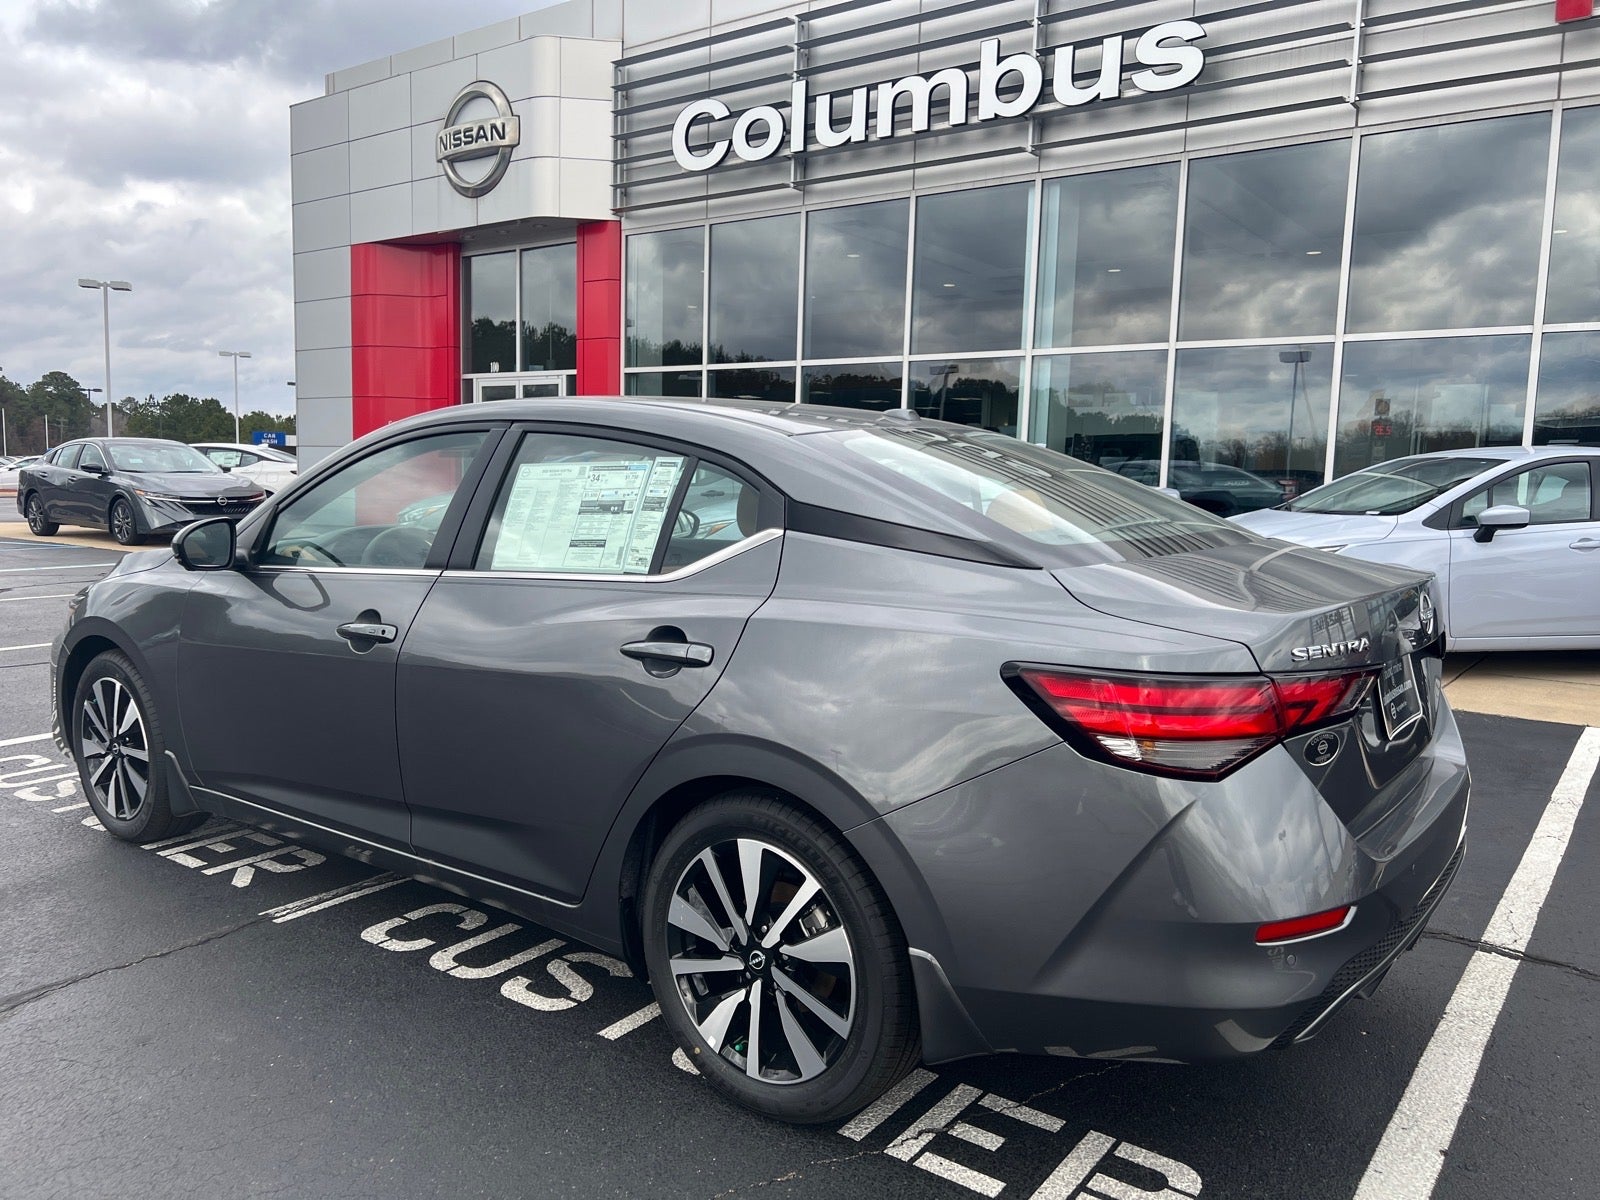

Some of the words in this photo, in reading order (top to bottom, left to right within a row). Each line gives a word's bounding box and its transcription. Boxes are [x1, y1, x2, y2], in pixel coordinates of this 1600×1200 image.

[671, 20, 1206, 171] Columbus
[438, 121, 506, 153] NISSAN
[490, 361, 500, 373] 100
[590, 473, 601, 482] 34
[1291, 637, 1370, 662] SENTRA
